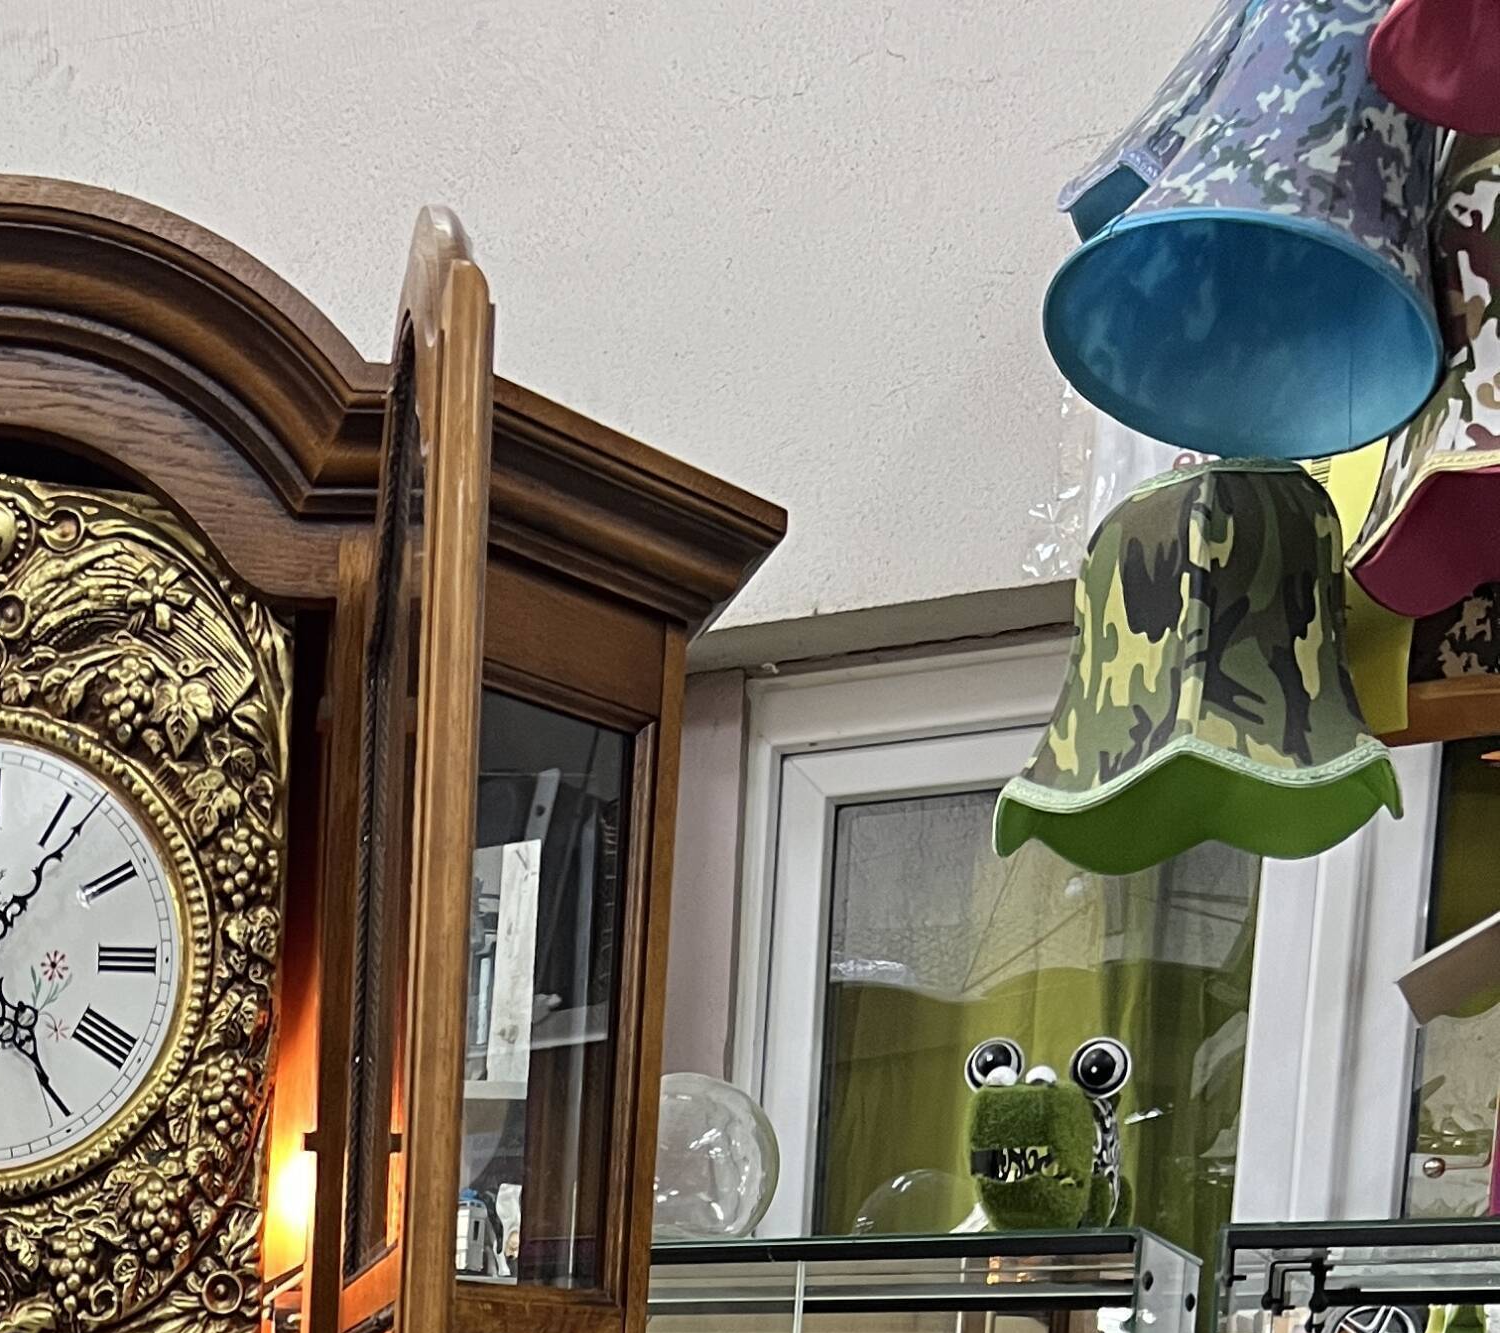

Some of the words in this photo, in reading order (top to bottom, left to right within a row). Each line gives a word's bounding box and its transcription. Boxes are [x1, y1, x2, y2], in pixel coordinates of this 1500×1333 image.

[38, 793, 74, 848] I
[80, 859, 140, 901] II
[97, 943, 158, 974] III
